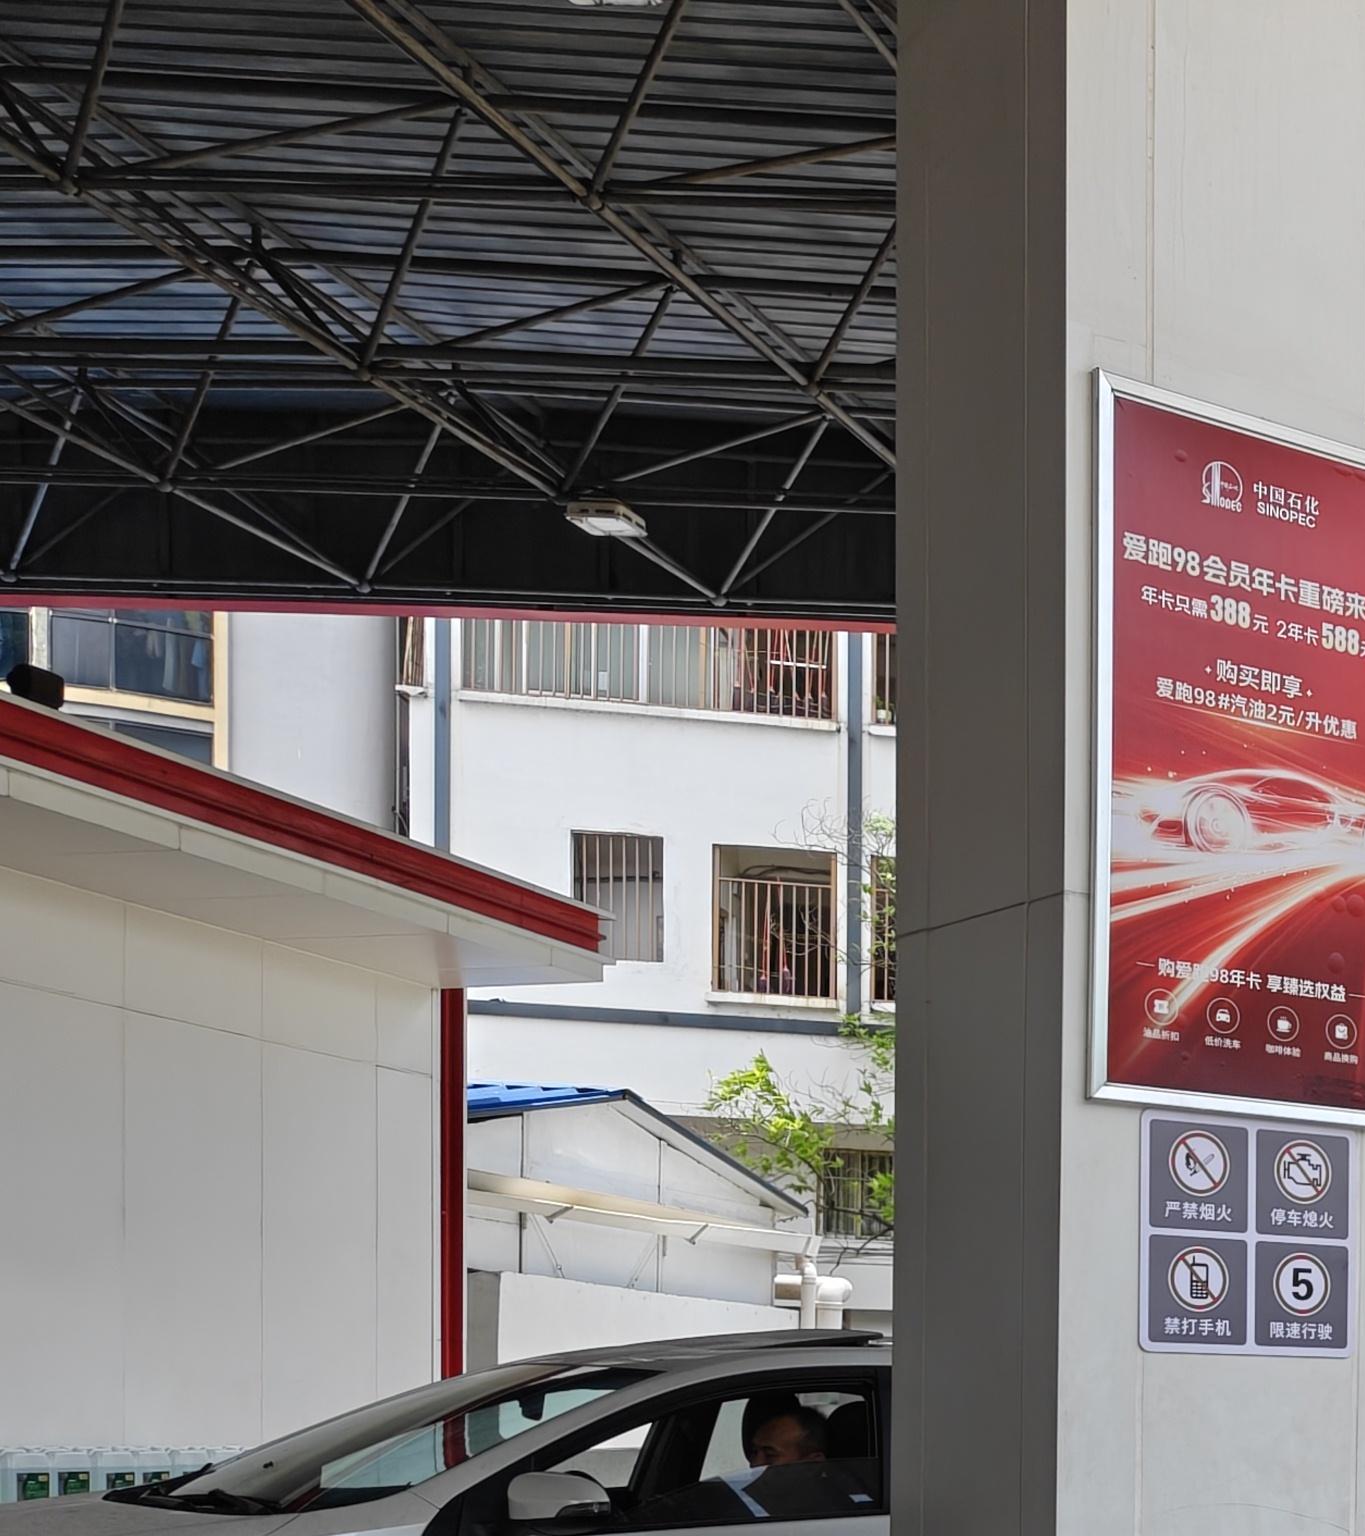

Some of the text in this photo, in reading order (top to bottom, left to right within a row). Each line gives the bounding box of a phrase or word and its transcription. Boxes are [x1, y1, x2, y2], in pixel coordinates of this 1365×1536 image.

[1253, 481, 1319, 516] 中国石化
[1257, 502, 1316, 528] SINOPEC
[1141, 585, 1269, 635] 年卡只需388元
[1216, 659, 1303, 698] 购买即享
[1156, 676, 1358, 739] 爱跑98#汽油2元/升优惠
[1158, 958, 1347, 1003] 购爱跑98年卡 享臻选权益
[1143, 1026, 1180, 1042] 油品折扣
[1204, 1035, 1241, 1050] 低价洗车
[1265, 1043, 1302, 1059] 咖啡体验
[1323, 1051, 1359, 1066] 商品换购
[1165, 1201, 1232, 1222] 严禁烟火
[1270, 1208, 1334, 1230] 停车熄火
[1291, 1267, 1314, 1301] 5
[1163, 1316, 1232, 1337] 禁打手机
[1269, 1321, 1333, 1341] 限速行驶
